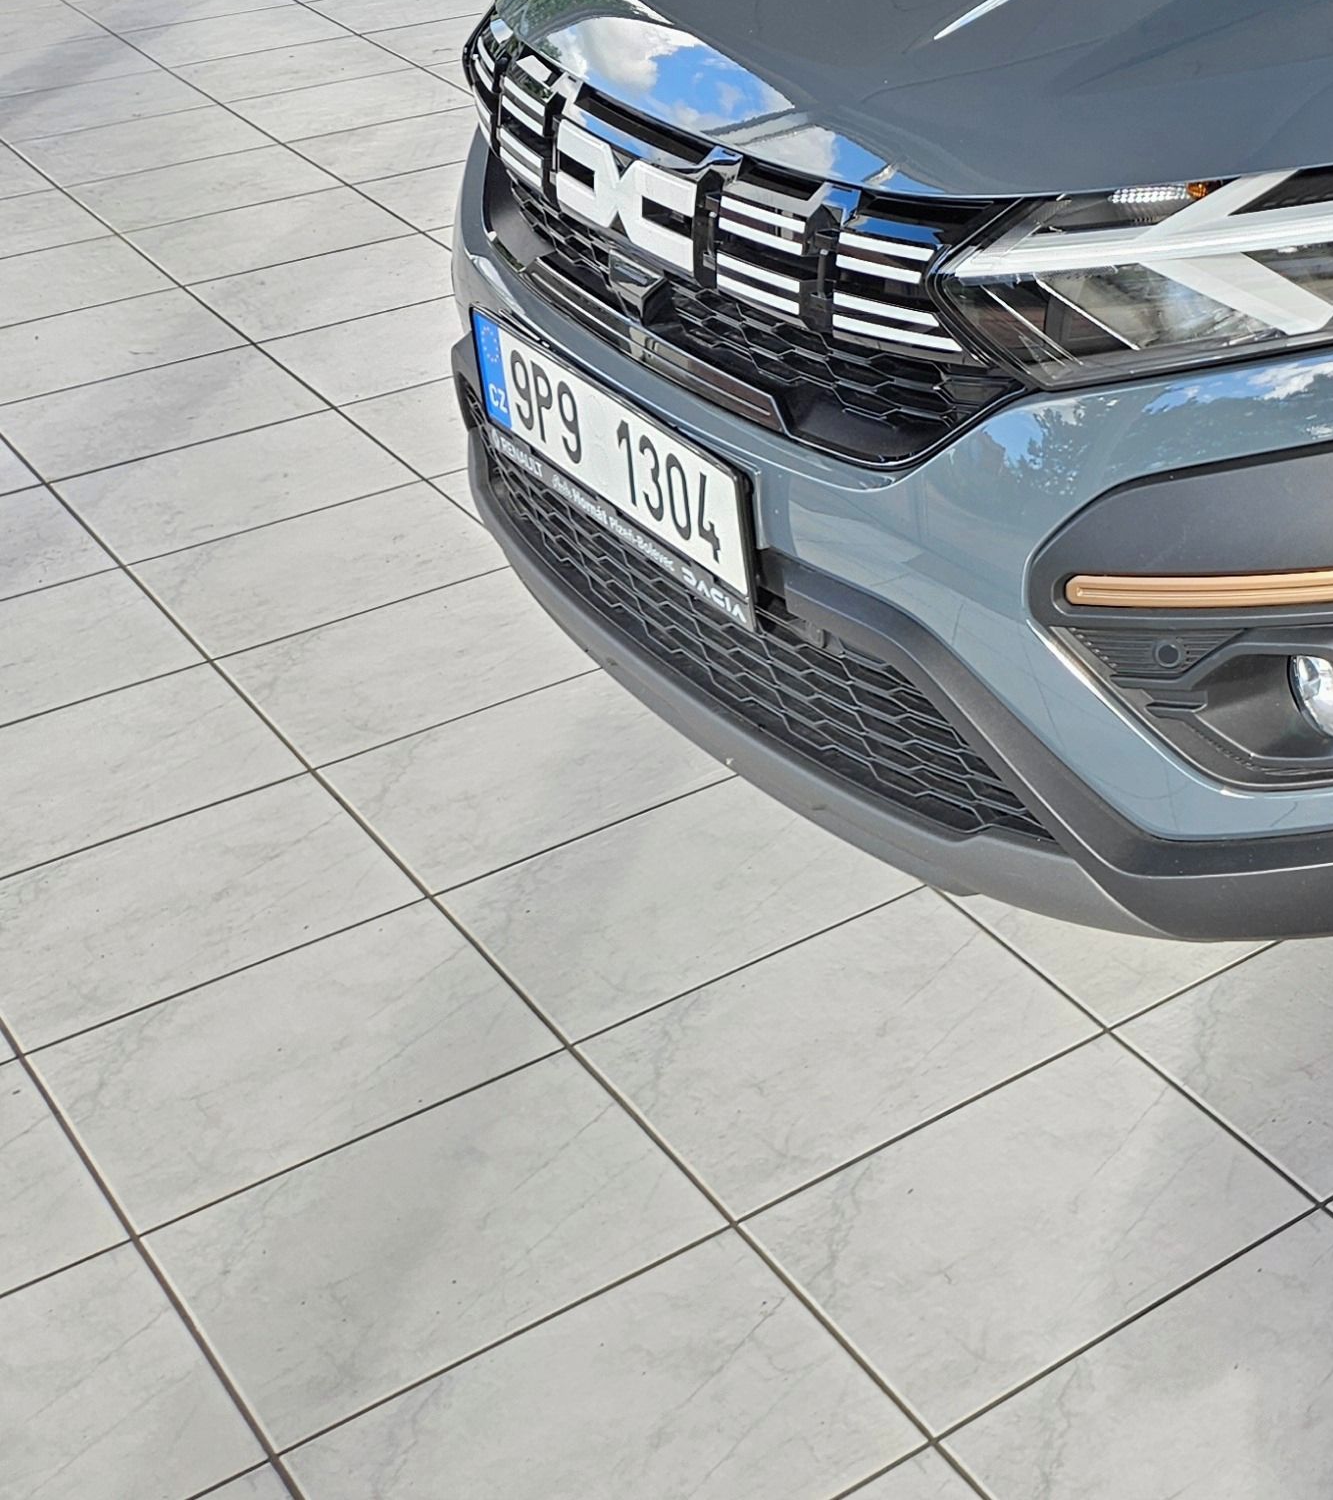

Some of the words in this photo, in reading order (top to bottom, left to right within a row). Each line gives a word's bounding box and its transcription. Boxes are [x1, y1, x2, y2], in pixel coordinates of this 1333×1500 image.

[488, 383, 508, 412] CZ
[510, 349, 582, 464] 9P9
[616, 419, 721, 564] 1304
[681, 566, 748, 623] DACIA
